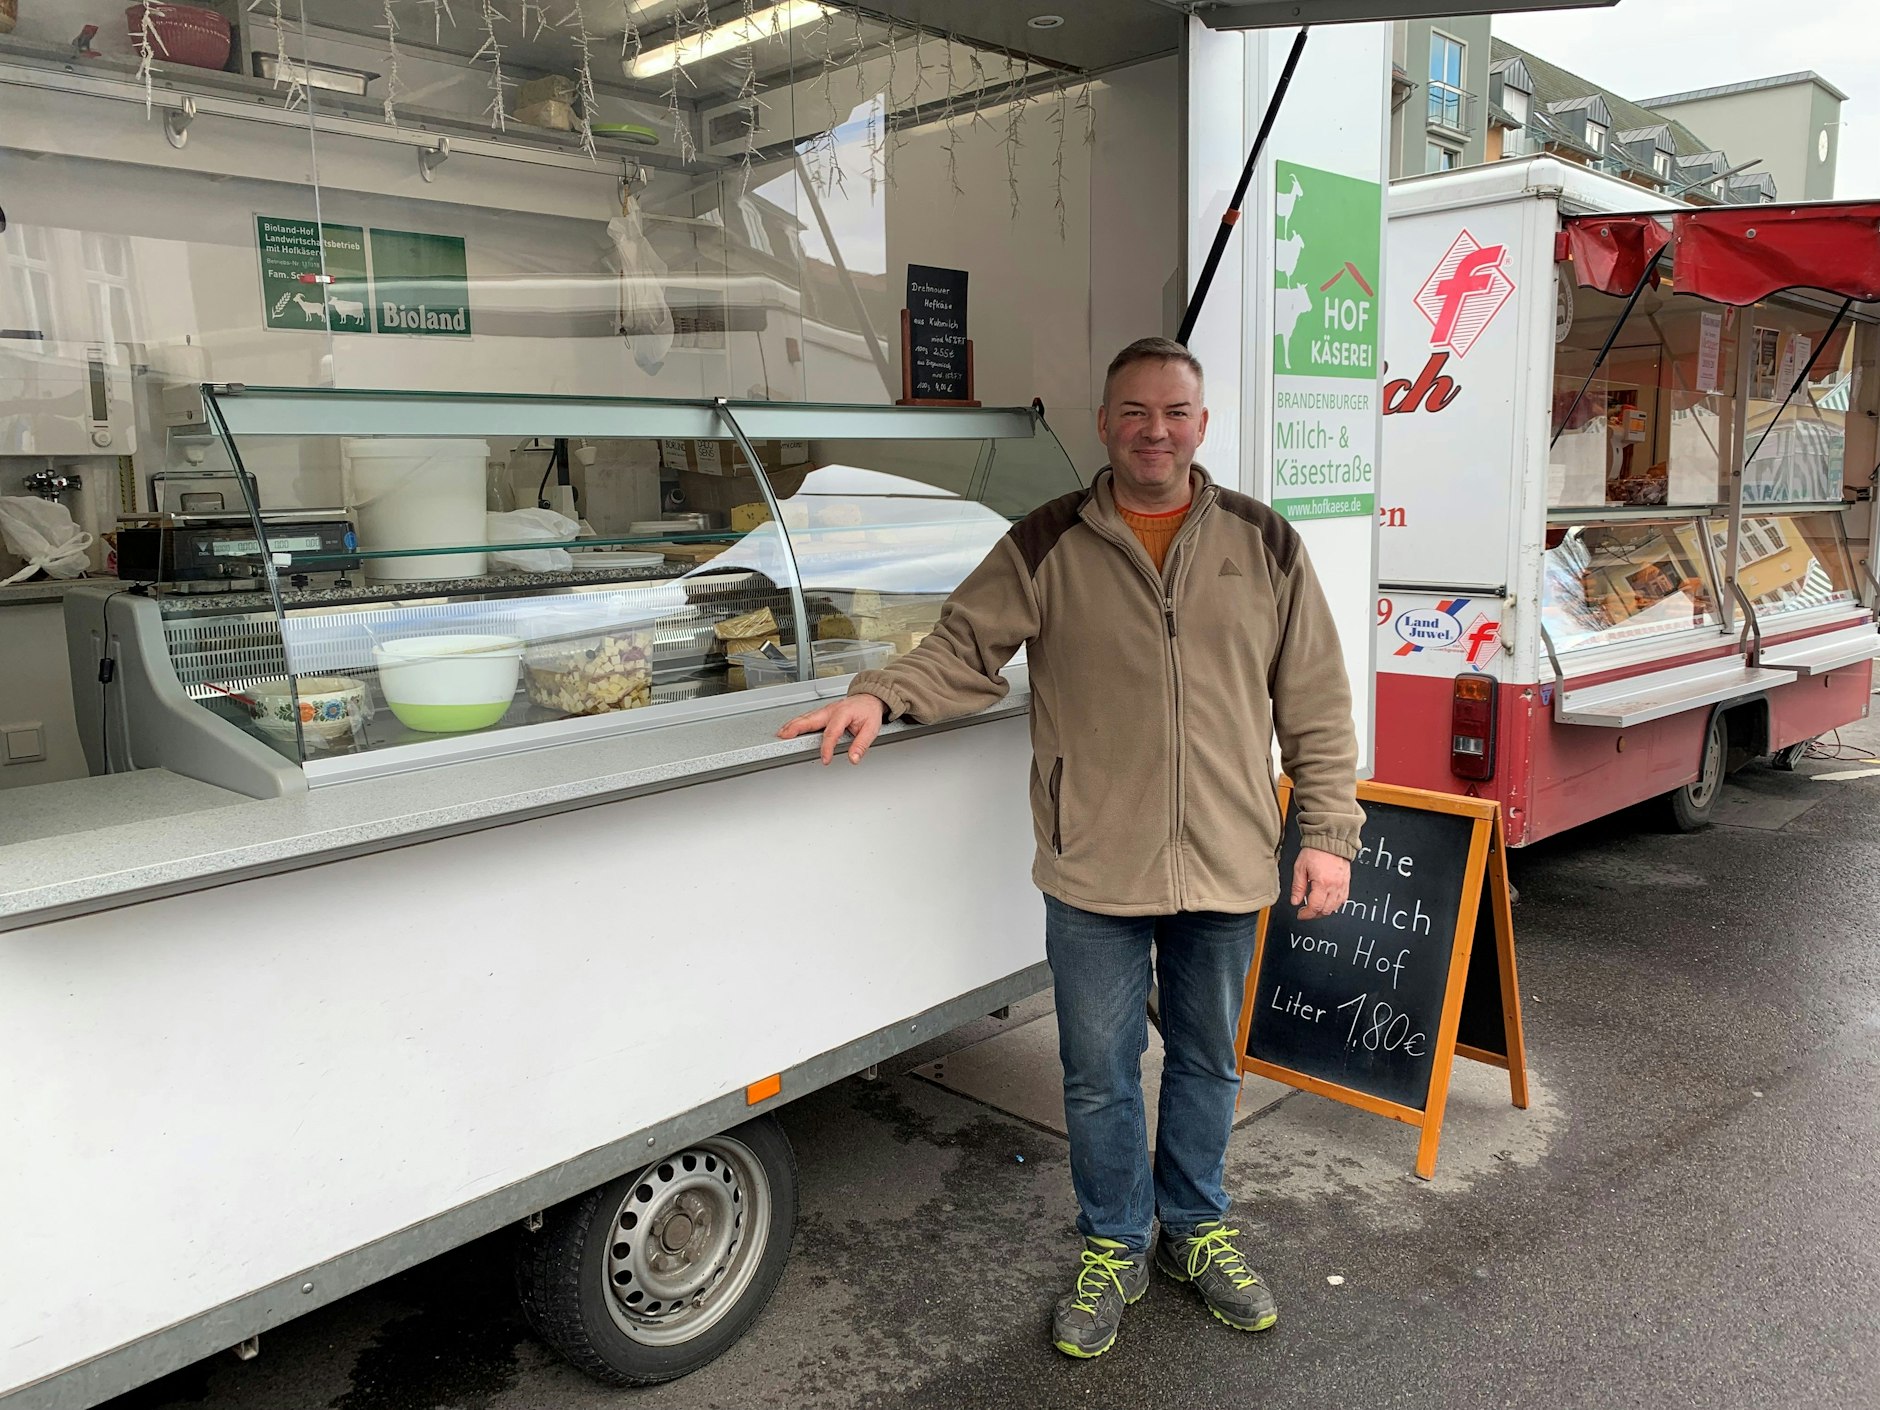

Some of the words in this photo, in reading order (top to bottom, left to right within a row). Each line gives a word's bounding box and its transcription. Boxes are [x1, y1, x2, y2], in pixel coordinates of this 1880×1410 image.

[264, 223, 314, 236] Bioland-Hof
[265, 233, 360, 250] Landwirtschatsbetrieb
[282, 245, 327, 257] Hofkäseri
[268, 270, 289, 279] Fam.
[382, 301, 466, 331] Bioland
[1324, 296, 1370, 332] HOF
[1311, 334, 1372, 367] KÄSEREI
[1383, 352, 1462, 416] ch
[1277, 391, 1369, 411] BRANDENBURGER
[1276, 420, 1334, 449] Milch-
[1338, 425, 1349, 449] &
[1276, 455, 1372, 486] Käsestraße
[1287, 497, 1361, 516] www.hofkaese.de
[1405, 616, 1439, 628] Land
[1409, 628, 1450, 640] Juwel
[1357, 836, 1414, 878] che
[1335, 893, 1432, 935] milch
[1290, 932, 1339, 958] vom
[1352, 935, 1411, 990] Hof
[1271, 985, 1327, 1023] Liter
[1336, 992, 1426, 1057] 1,80€
